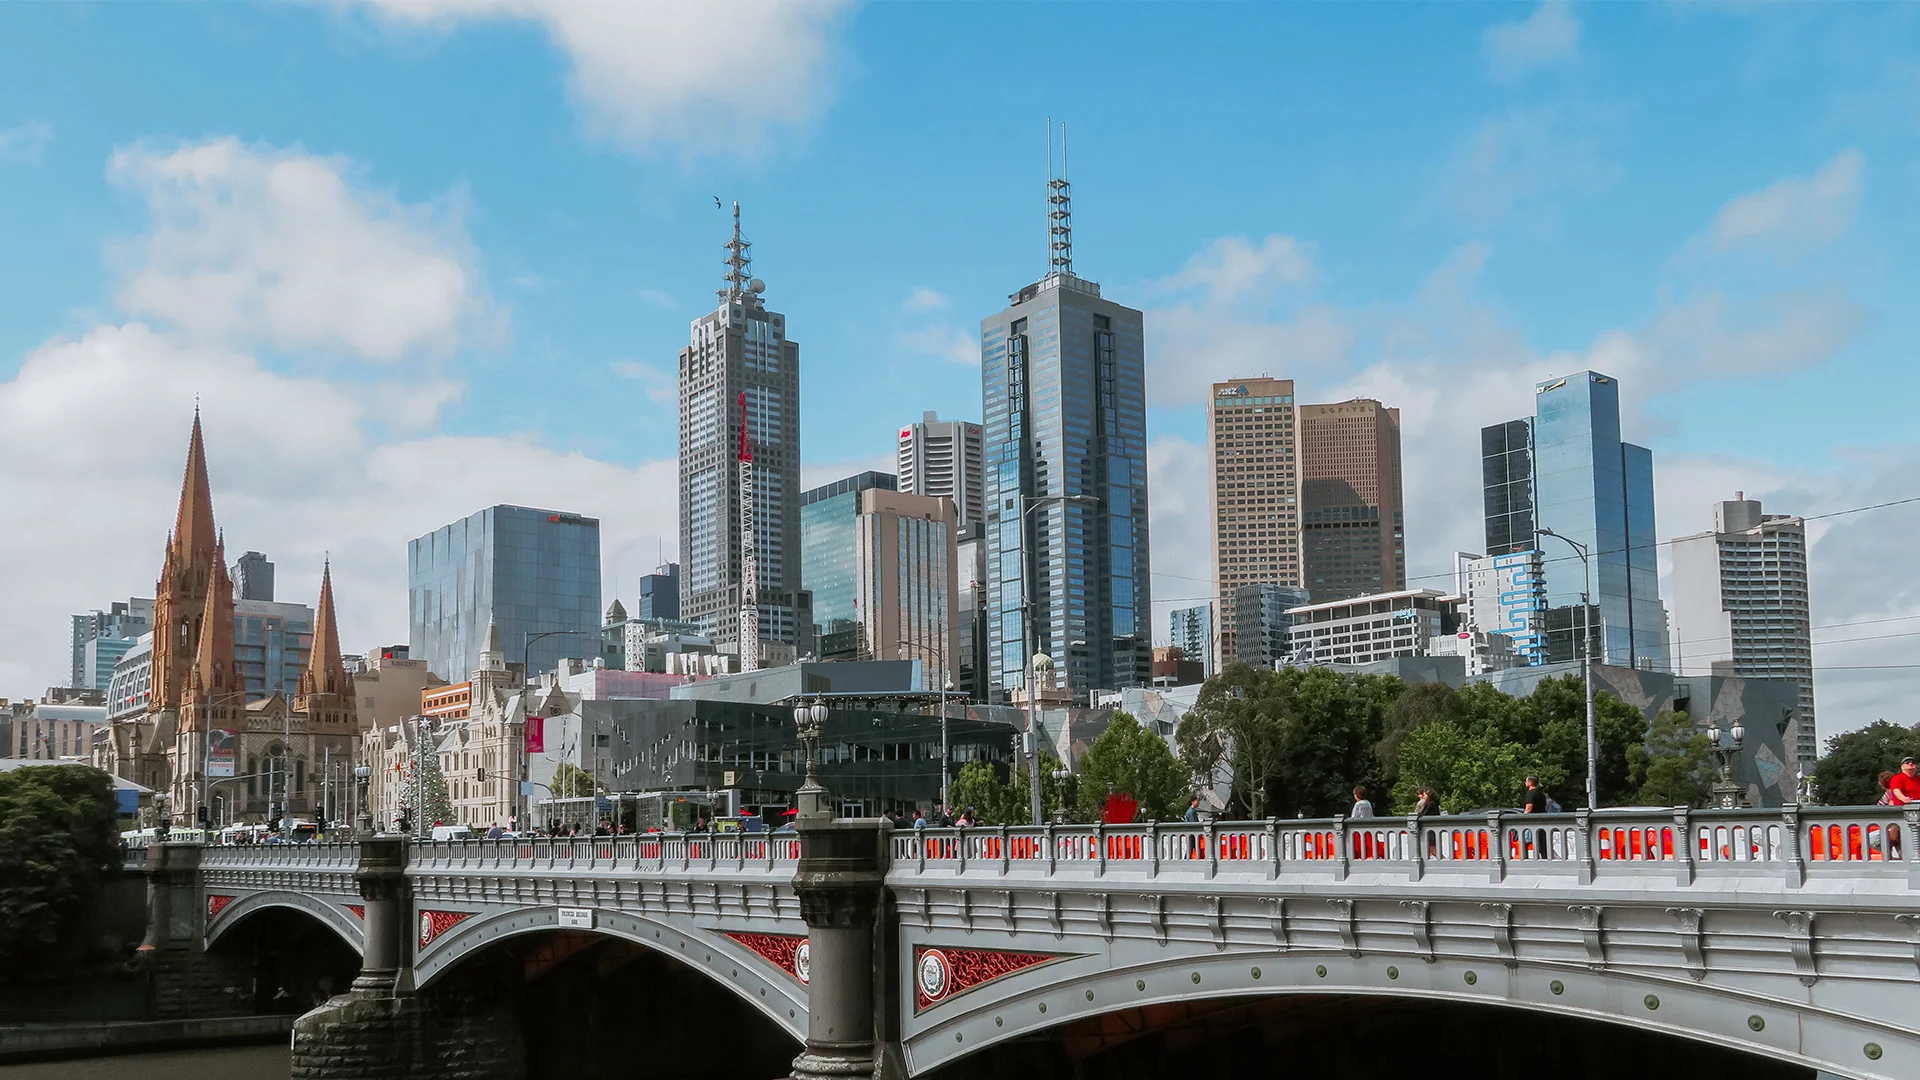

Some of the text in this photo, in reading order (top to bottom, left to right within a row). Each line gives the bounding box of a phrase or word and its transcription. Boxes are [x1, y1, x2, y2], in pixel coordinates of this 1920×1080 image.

[1218, 387, 1238, 396] ANZ
[1536, 386, 1545, 394] EY
[1320, 406, 1374, 414] SOFITEL
